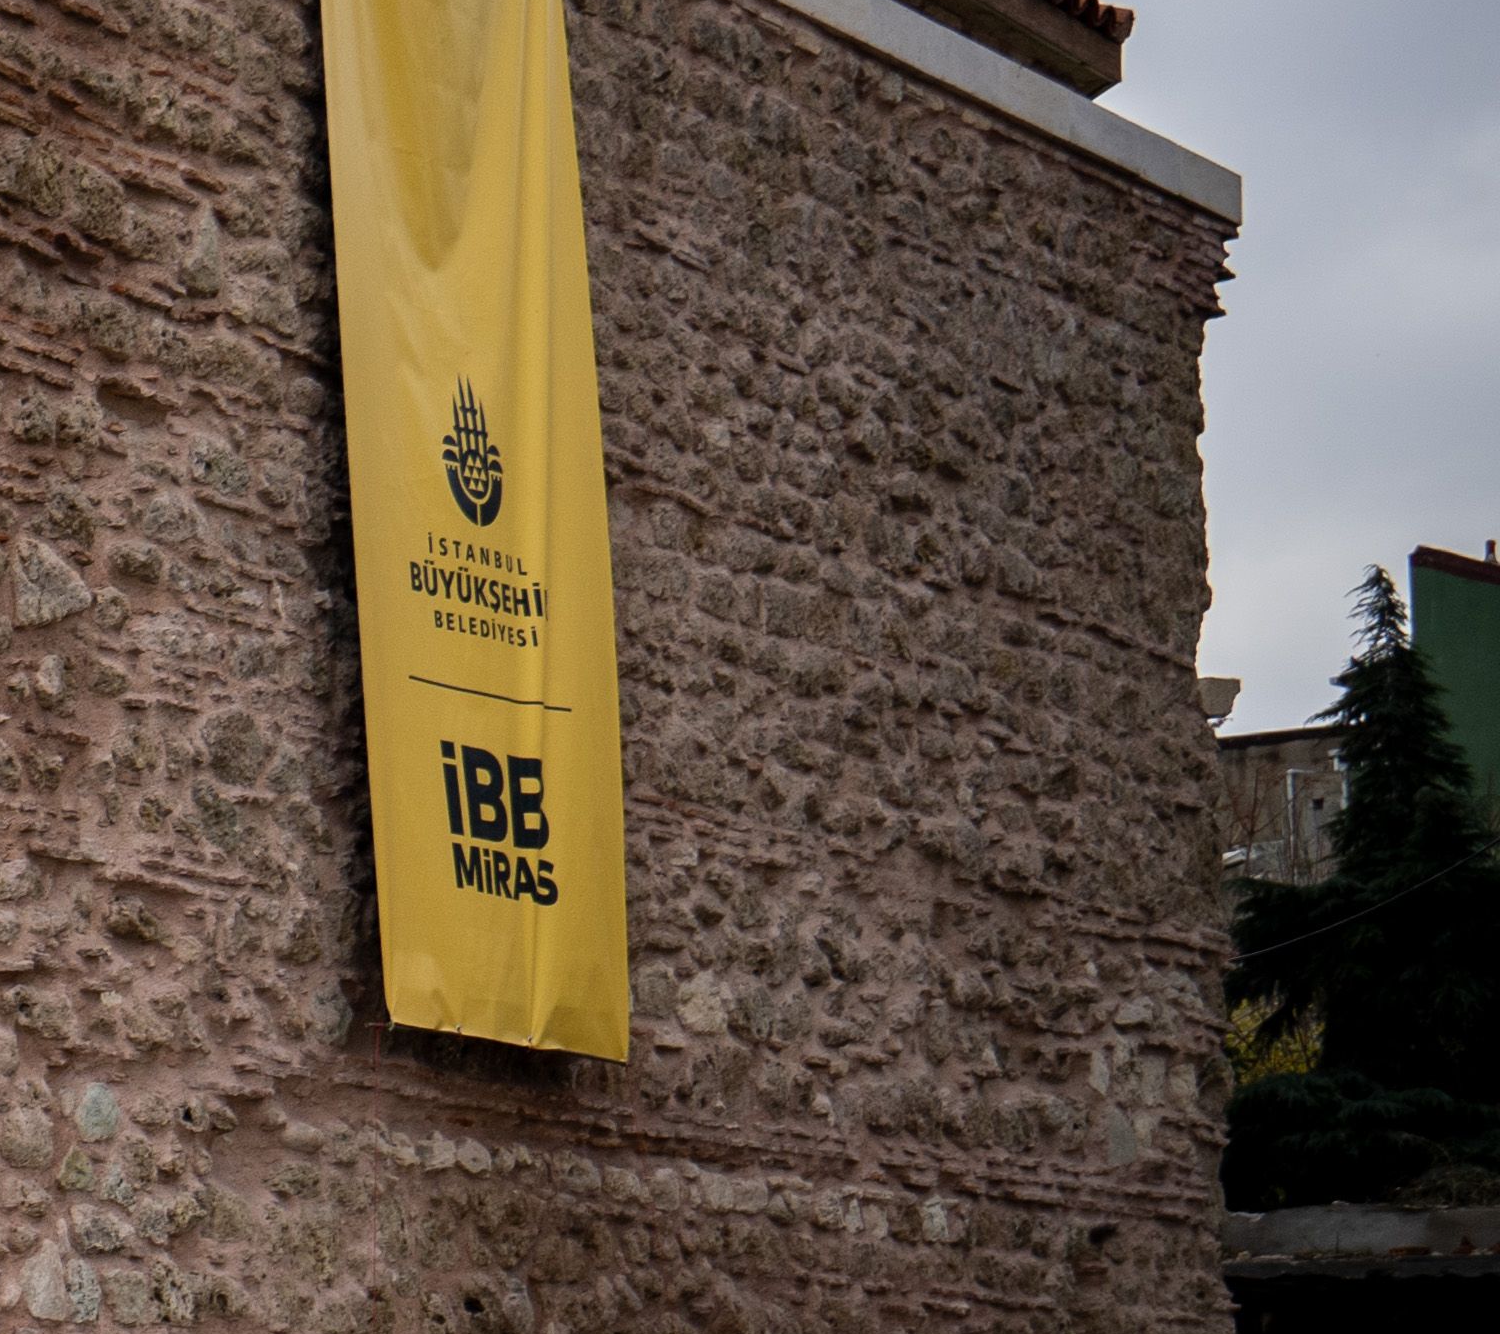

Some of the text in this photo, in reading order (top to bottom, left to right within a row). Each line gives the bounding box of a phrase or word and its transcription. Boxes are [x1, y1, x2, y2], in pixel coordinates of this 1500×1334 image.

[427, 532, 528, 576] İSTANBUL
[409, 559, 549, 622] BÜYÜKŞEHİ
[433, 609, 539, 648] BELEDİYESİ
